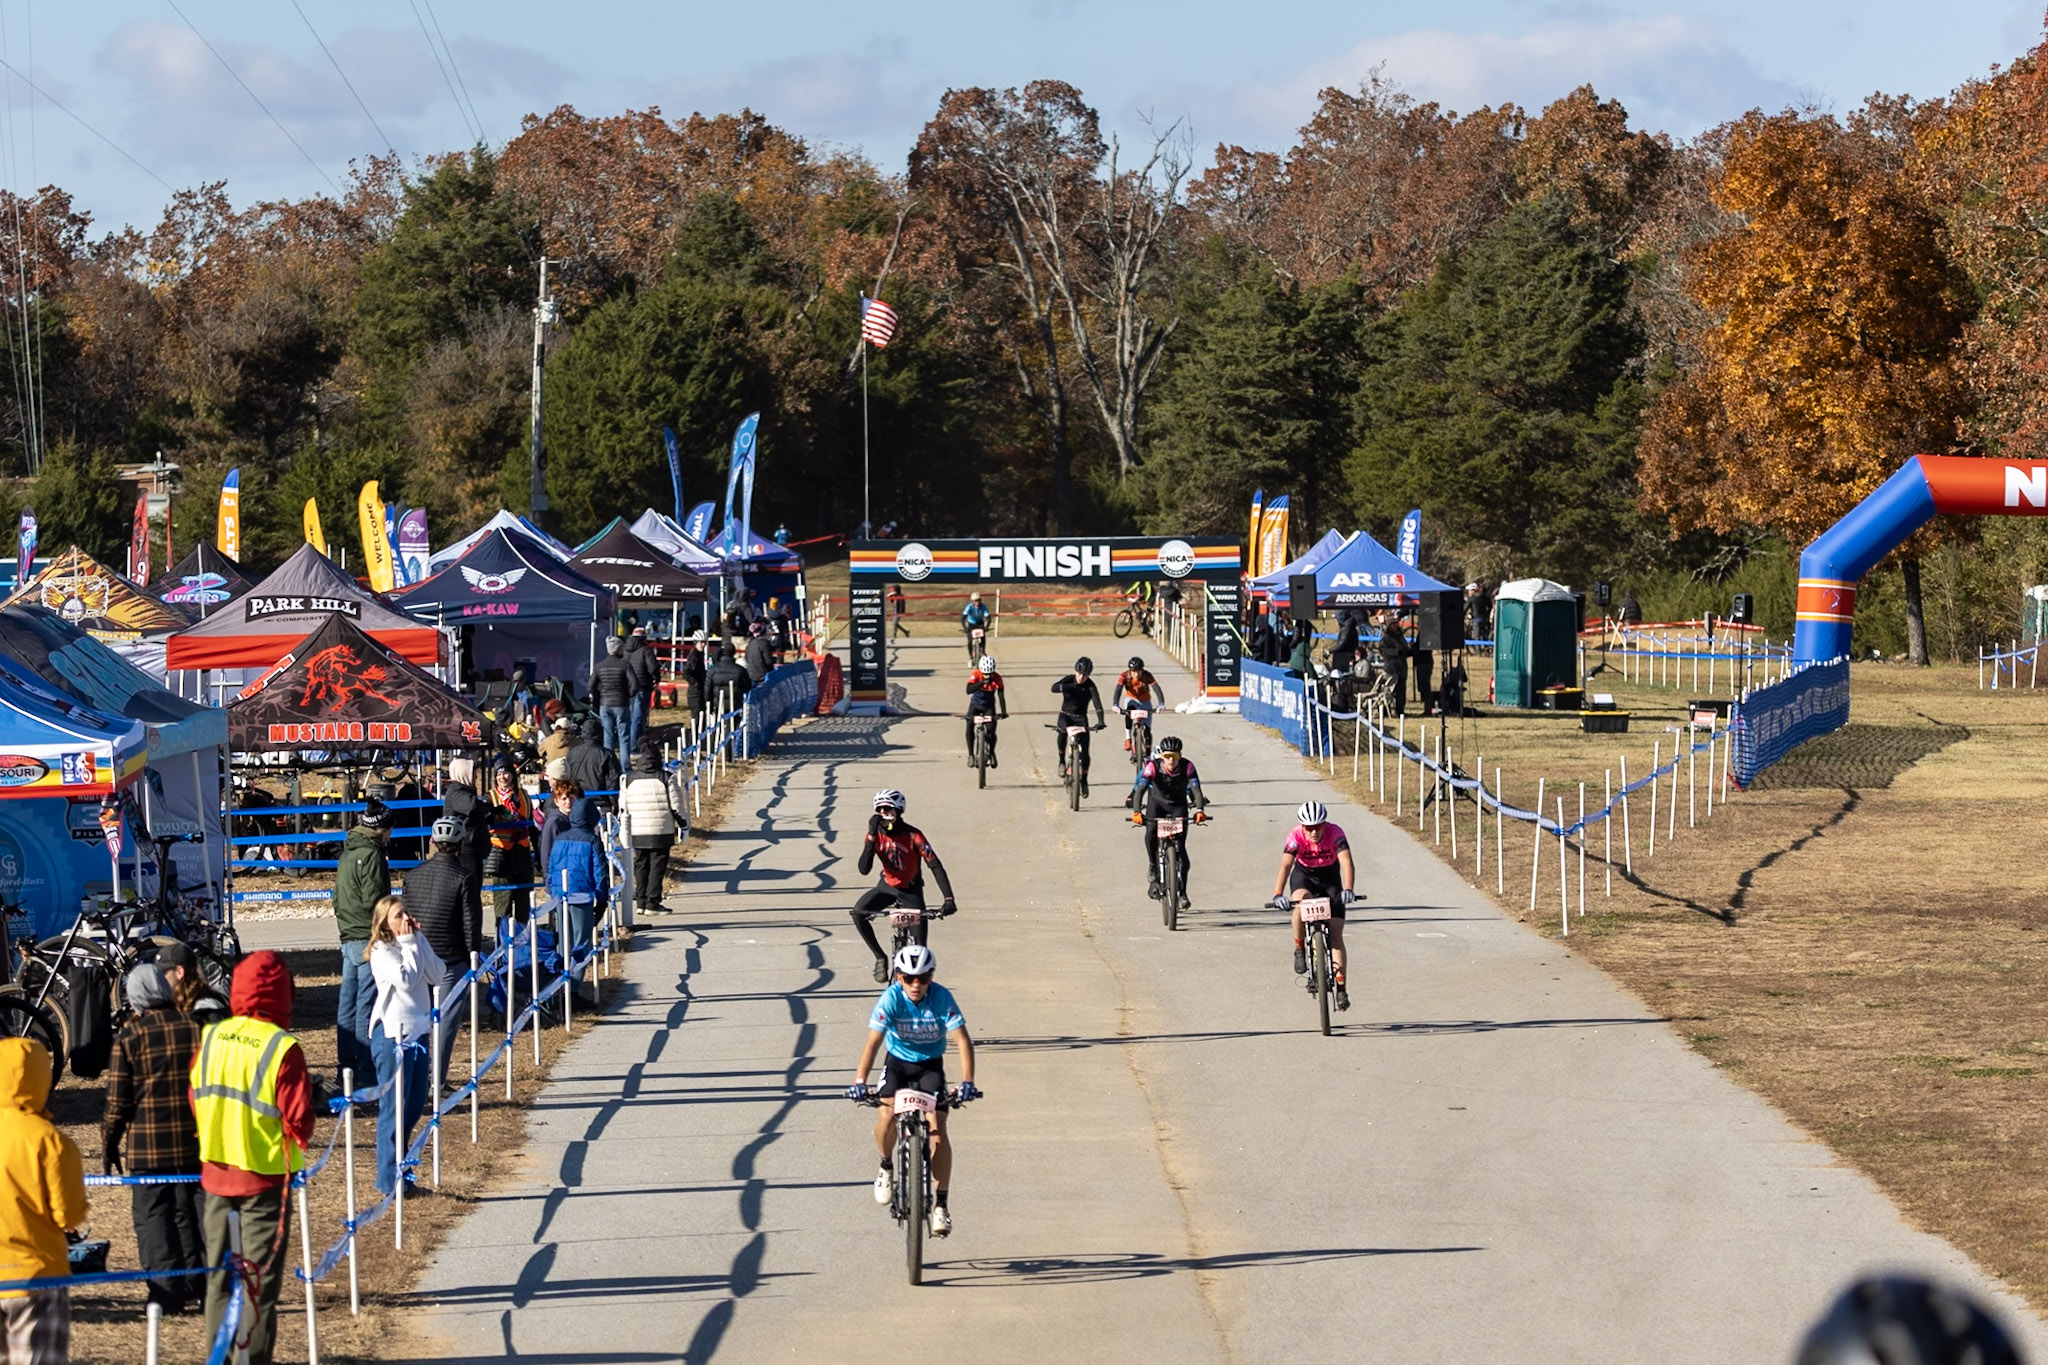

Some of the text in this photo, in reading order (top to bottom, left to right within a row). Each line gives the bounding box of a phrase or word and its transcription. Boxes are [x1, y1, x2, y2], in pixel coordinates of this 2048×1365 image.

[366, 503, 384, 564] WELCOME
[580, 557, 655, 568] TREK
[980, 545, 1111, 577] FINISH
[1166, 555, 1188, 563] NICA
[1330, 572, 1375, 588] AR
[622, 583, 664, 597] ZONE
[1335, 593, 1388, 603] ARKANSAS
[250, 597, 358, 617] PARK HILL
[463, 603, 519, 616] KA-KAW
[268, 721, 412, 744] MUSTANG MTB
[0, 768, 35, 778] SOURI
[64, 755, 75, 783] NICA
[242, 892, 283, 901] SHIMANO
[291, 890, 332, 899] SHIMANO
[1306, 905, 1326, 915] 1119
[217, 1032, 261, 1048] PARKING
